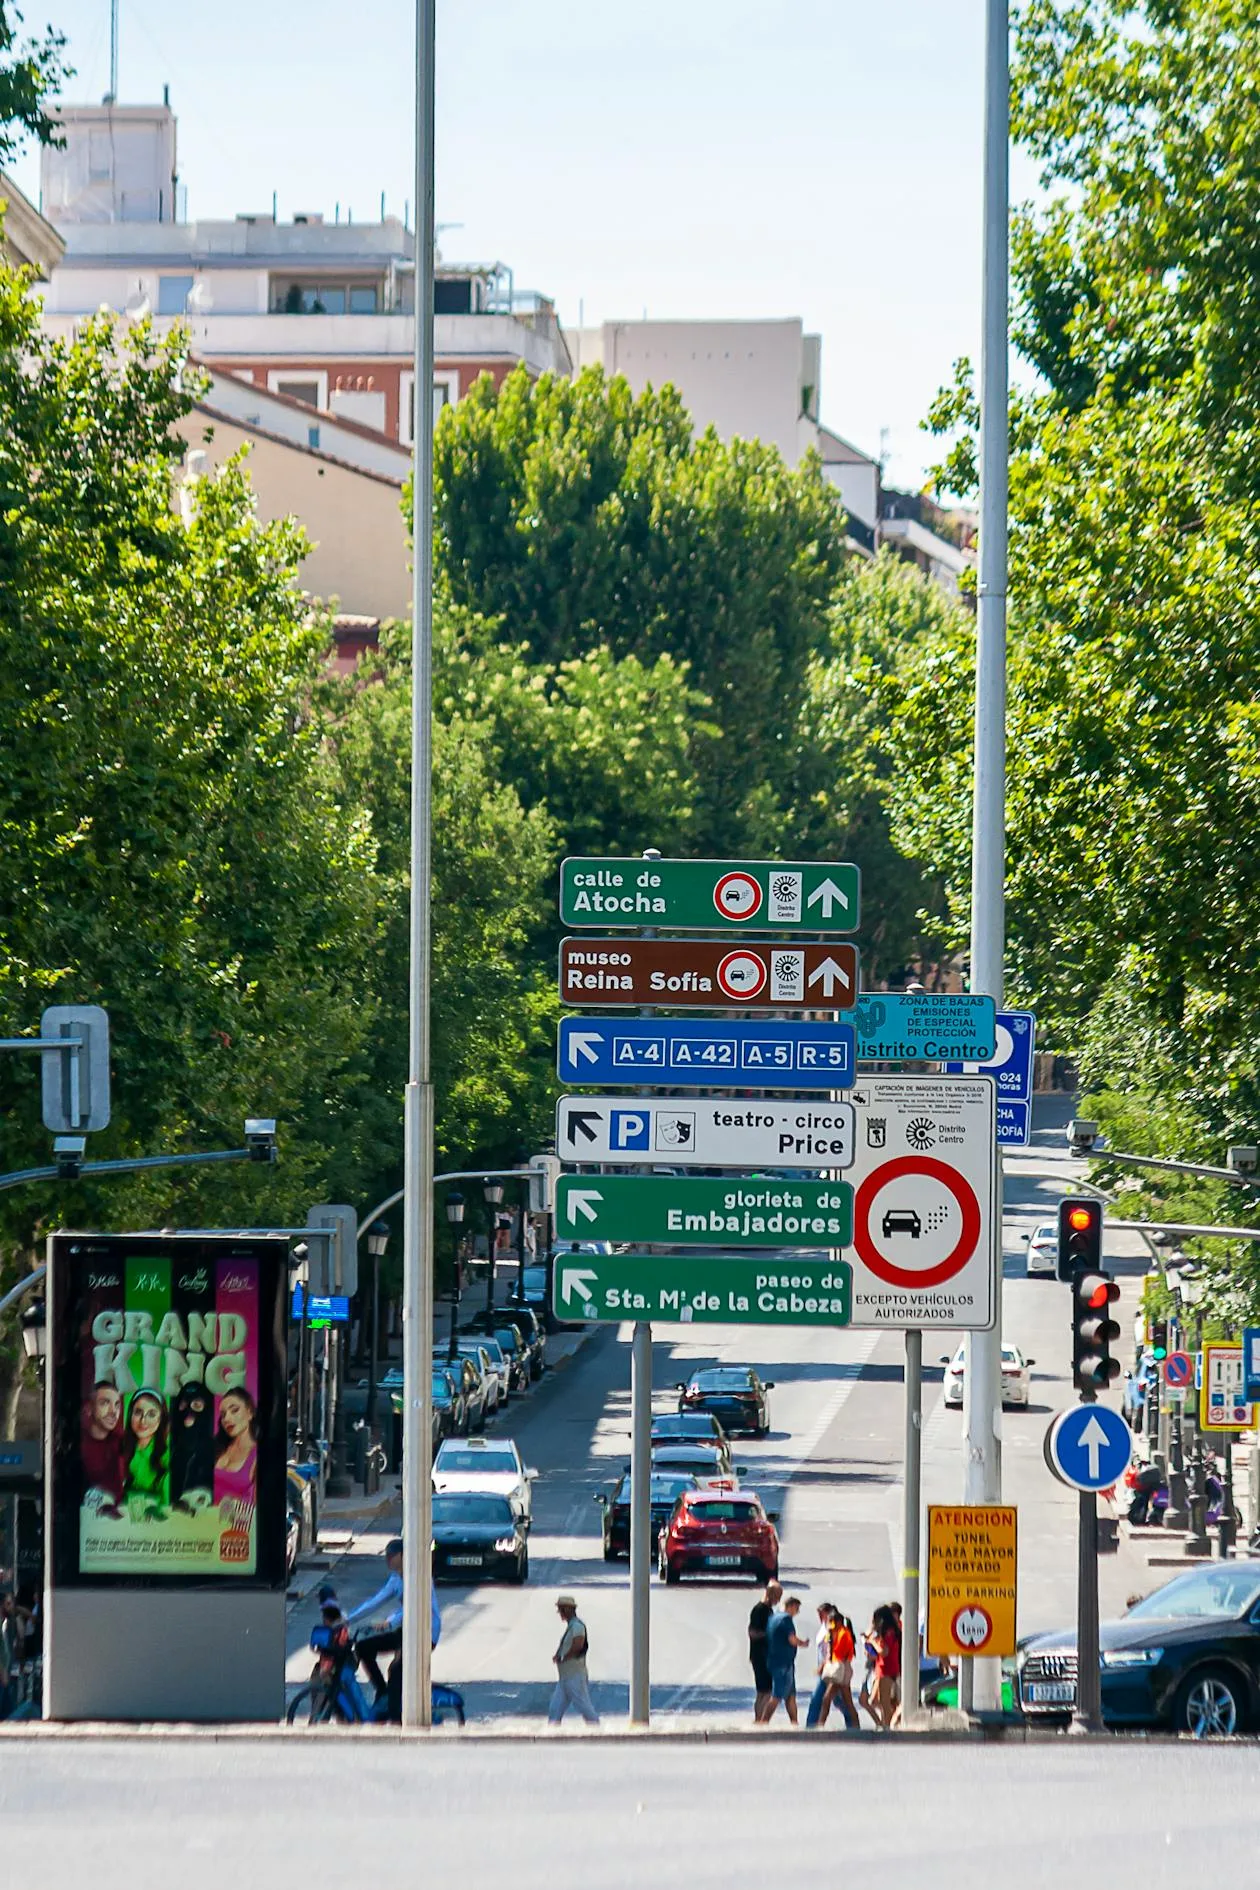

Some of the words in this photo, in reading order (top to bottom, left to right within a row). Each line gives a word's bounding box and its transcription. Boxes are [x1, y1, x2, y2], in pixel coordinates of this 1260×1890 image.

[573, 871, 624, 887] calle
[636, 871, 661, 887] de
[573, 891, 666, 913] Atocha
[568, 952, 632, 965] museo
[567, 970, 634, 990] Reina
[650, 971, 713, 992] Sofía
[899, 997, 929, 1006] ZONA
[931, 997, 948, 1006] DE
[950, 997, 984, 1007] BAJAS
[913, 1007, 970, 1016] EMISIONES
[907, 1018, 922, 1026] DE
[924, 1018, 976, 1027] ESPECIAL
[907, 1027, 976, 1037] PROTECCIÓN
[619, 1043, 660, 1061] A-4
[676, 1044, 731, 1063] A-42
[748, 1045, 788, 1065] A-5
[802, 1047, 842, 1065] R-5
[923, 1041, 989, 1058] Centro
[713, 1111, 774, 1127] teatro
[795, 1113, 845, 1129] circo
[618, 1114, 645, 1147] P
[939, 1125, 966, 1133] Distrito
[779, 1134, 844, 1154] Price
[939, 1135, 964, 1144] Centro
[724, 1190, 802, 1210] glorieta
[816, 1192, 841, 1209] de
[667, 1209, 841, 1237] Embajadores
[756, 1275, 813, 1290] paseo
[821, 1274, 844, 1289] de
[605, 1289, 651, 1309] Sta.
[692, 1291, 721, 1311] de
[728, 1291, 749, 1311] la
[758, 1292, 843, 1314] Cabeza
[856, 1295, 907, 1305] EXCEPTO
[910, 1292, 974, 1305] VEHÍCULOS
[875, 1308, 954, 1318] AUTORIZADOS
[92, 1310, 247, 1354] GRAND
[93, 1342, 247, 1396] KING
[934, 1511, 1012, 1527] ATENCIÓN
[931, 1546, 967, 1558] PLAZA
[973, 1547, 1014, 1558] MAYOR
[945, 1561, 1000, 1573] CORTADO
[966, 1587, 1015, 1599] PARKING
